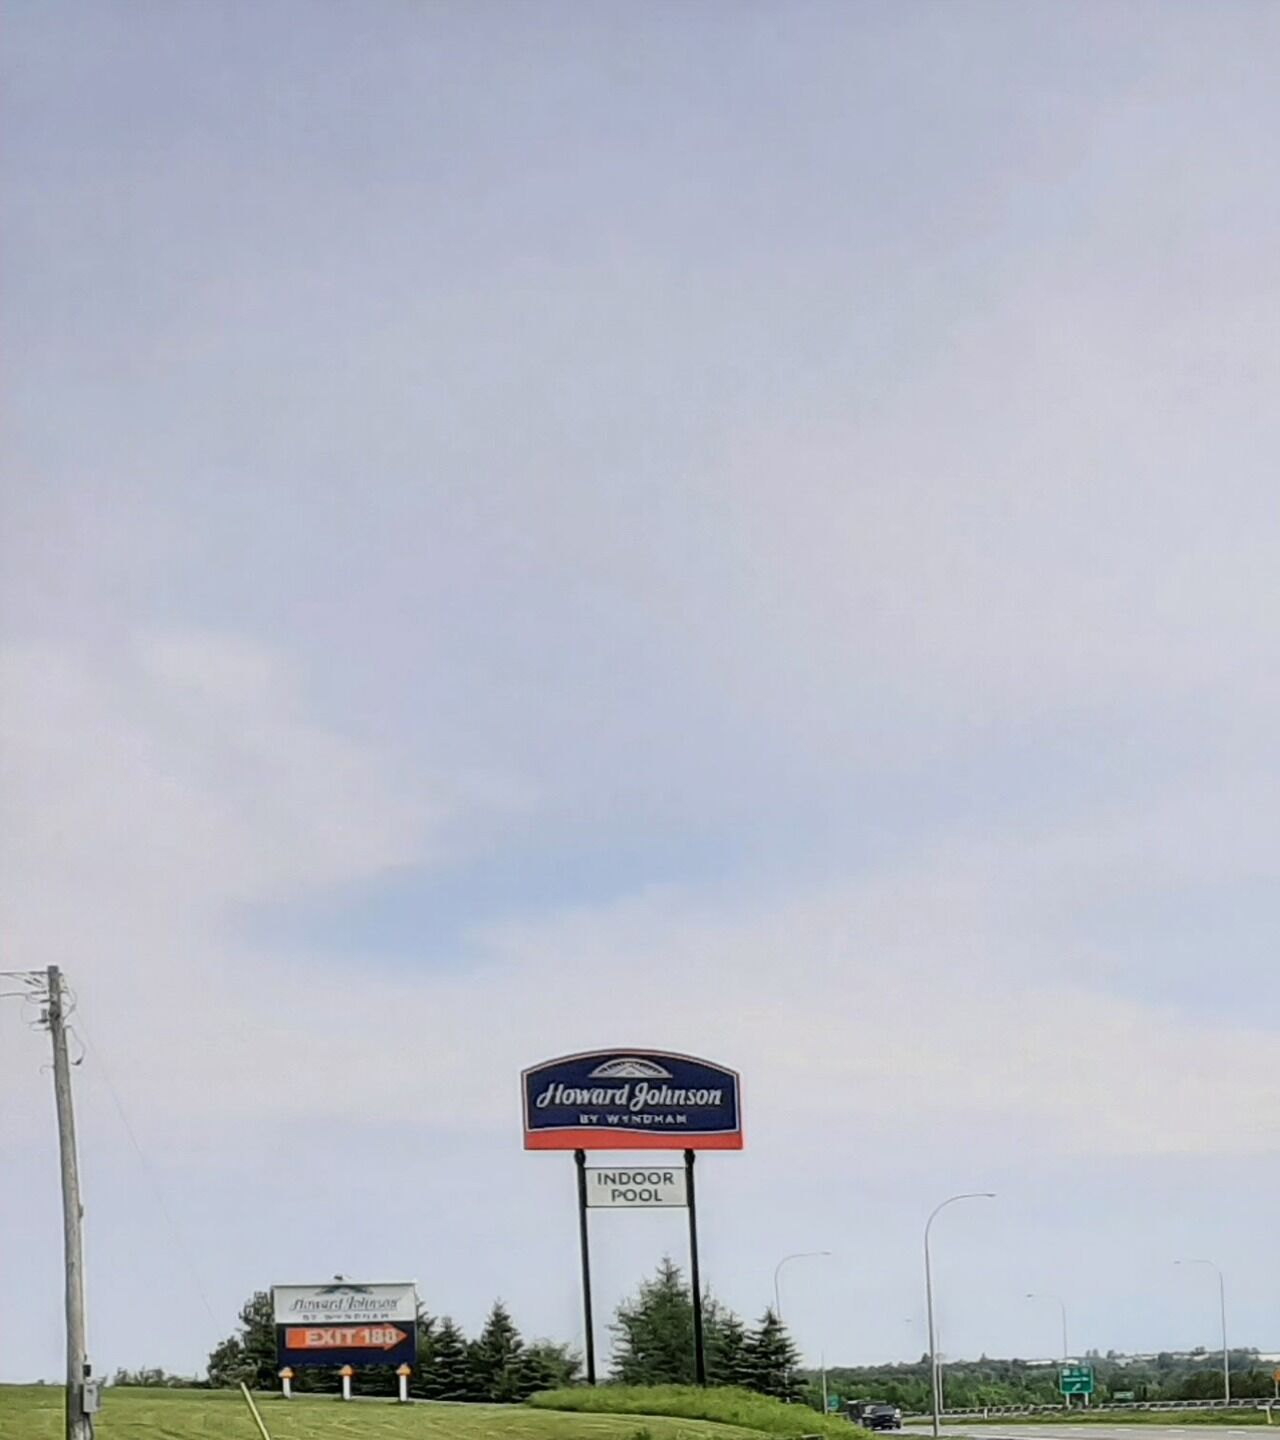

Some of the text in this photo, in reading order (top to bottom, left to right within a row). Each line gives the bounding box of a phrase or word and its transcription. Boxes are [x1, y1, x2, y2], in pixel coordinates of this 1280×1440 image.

[536, 1082, 722, 1112] Howard Johnson
[579, 1114, 688, 1124] BY WYNDHAM
[596, 1172, 674, 1185] INDOOR
[611, 1188, 663, 1202] POOL
[289, 1297, 344, 1311] Howard
[305, 1329, 357, 1345] EXIT
